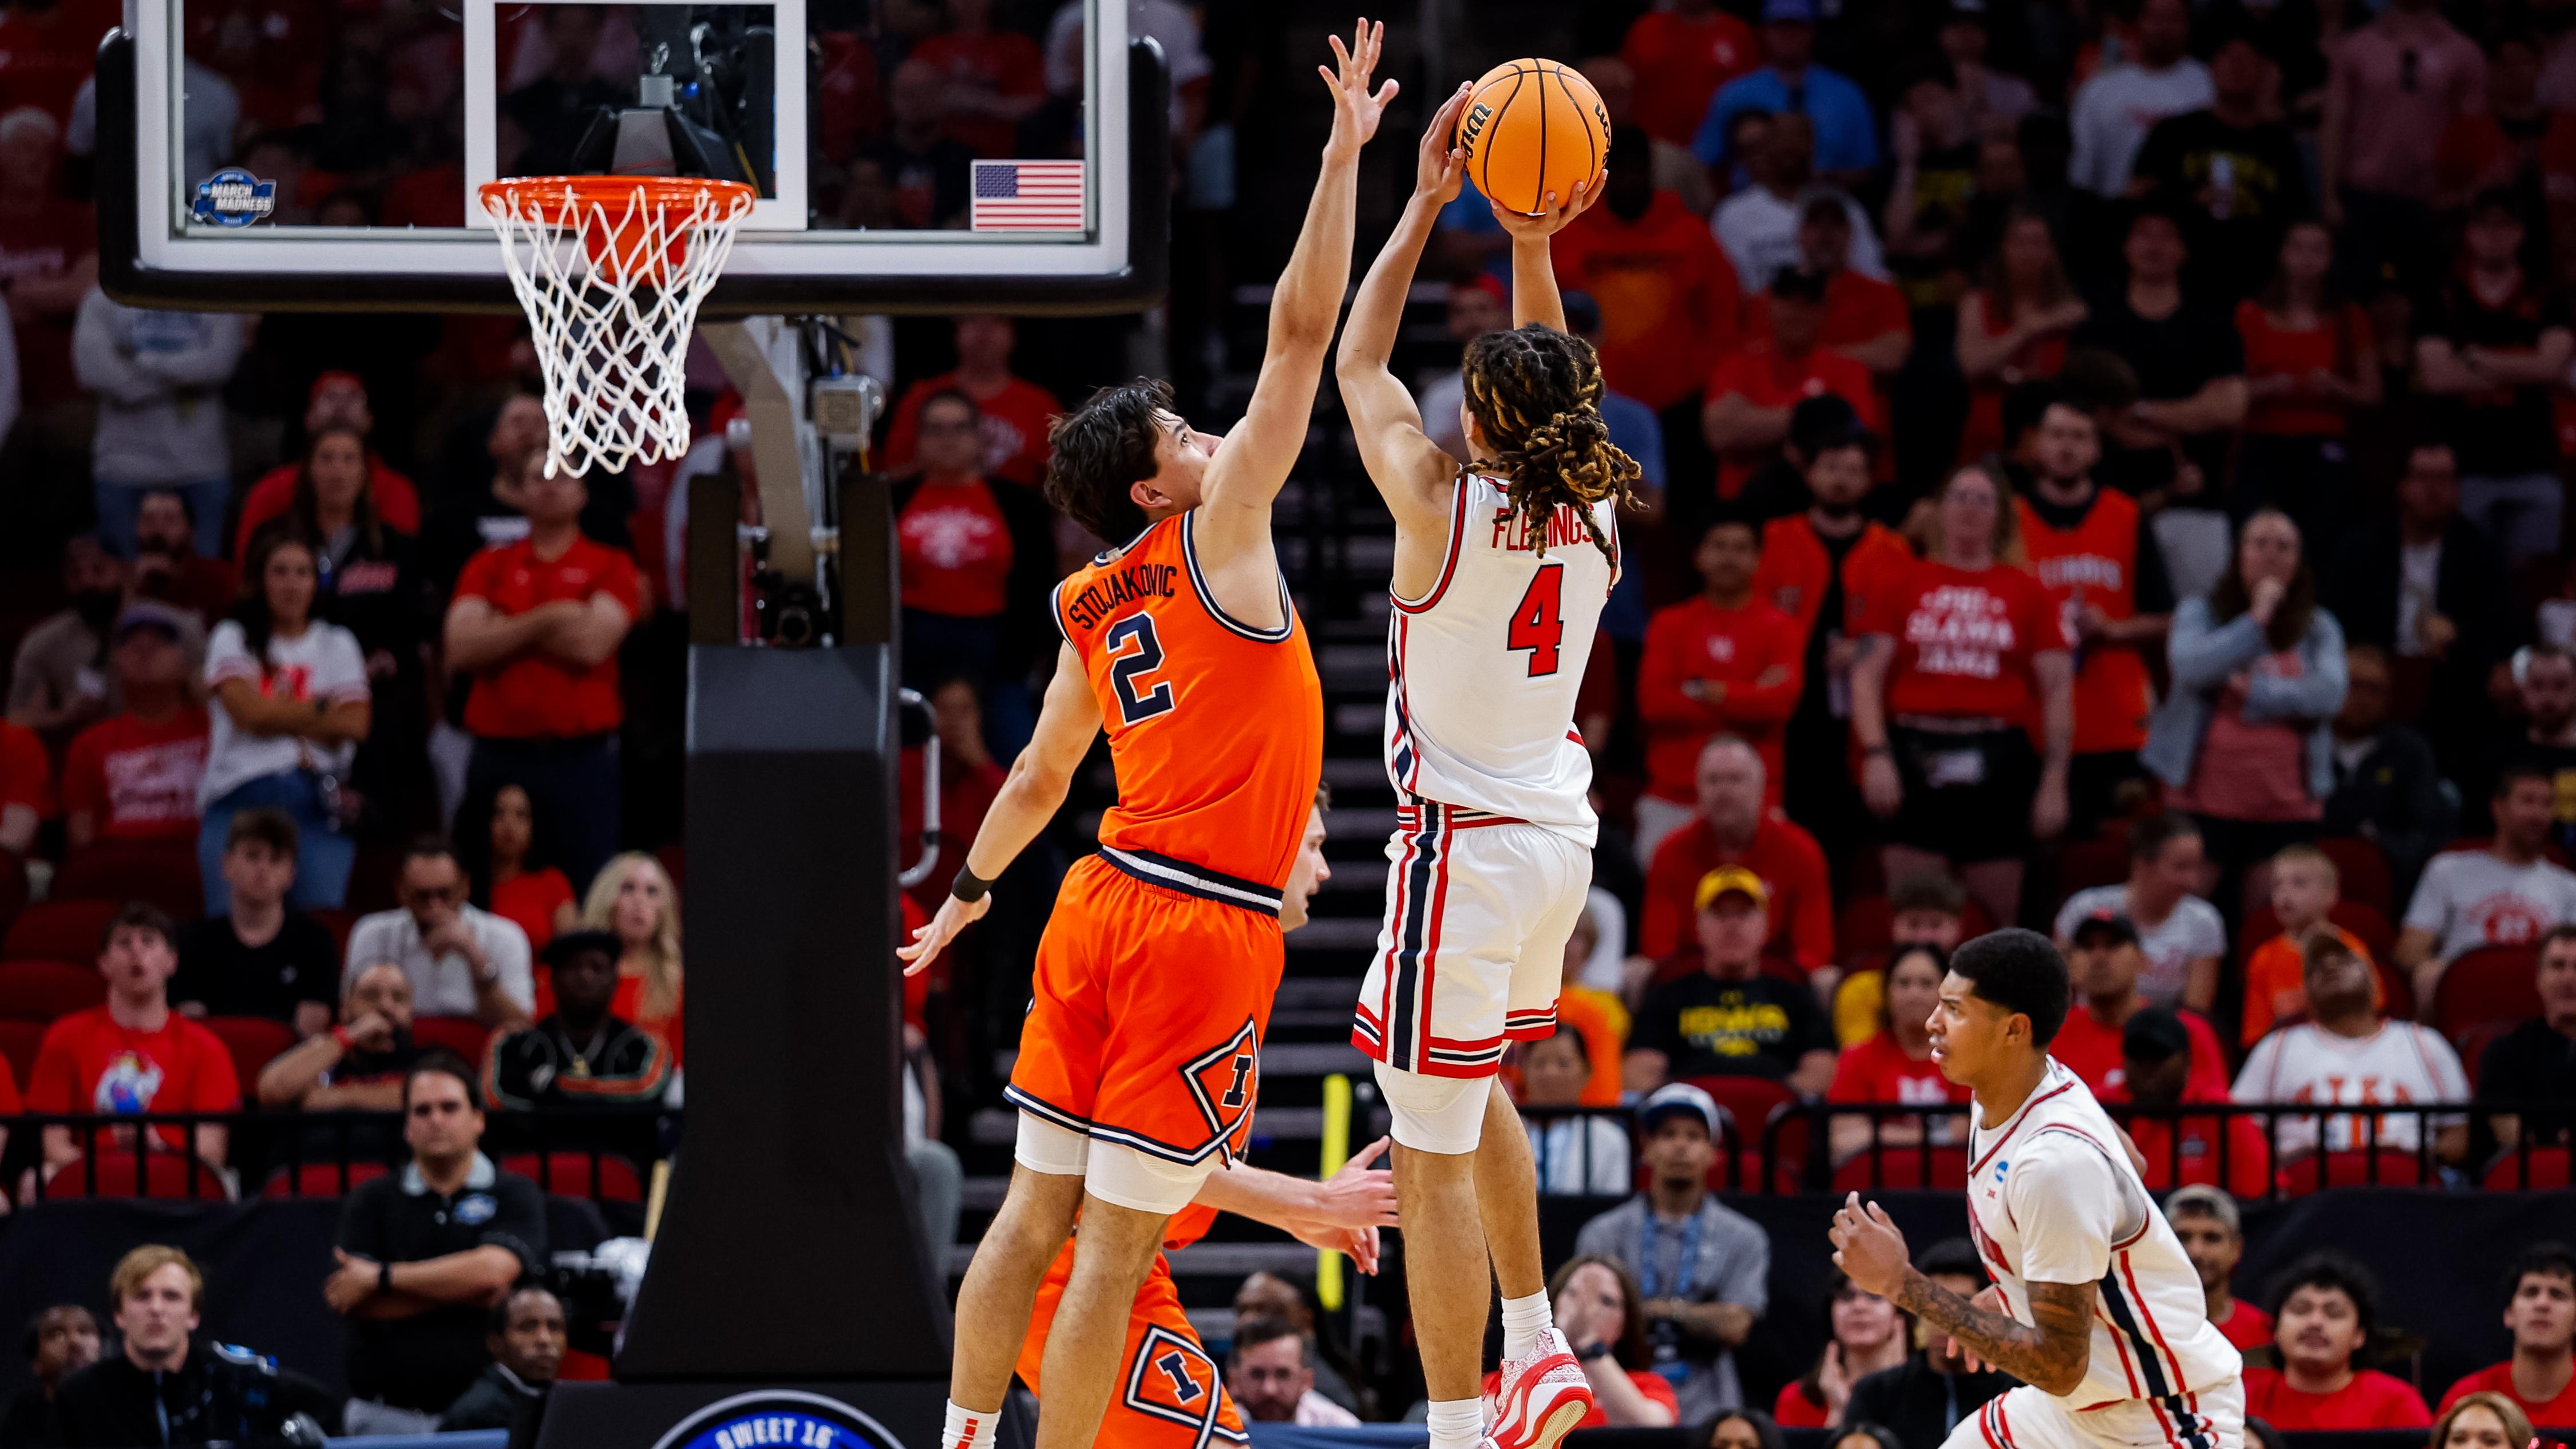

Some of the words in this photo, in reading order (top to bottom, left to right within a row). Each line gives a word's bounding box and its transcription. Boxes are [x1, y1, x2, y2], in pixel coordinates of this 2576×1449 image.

[1461, 102, 1494, 172] Wil
[211, 183, 252, 199] MARCH
[215, 197, 271, 211] MADNESS
[1492, 504, 1594, 551] FLEING
[1069, 563, 1177, 630] STOJAKOVIC
[1507, 563, 1564, 678] 4
[1106, 610, 1176, 726] 2
[1221, 1054, 1253, 1108] I
[1155, 1349, 1205, 1406] I
[715, 1417, 798, 1449] SWEET
[801, 1420, 833, 1449] 16
